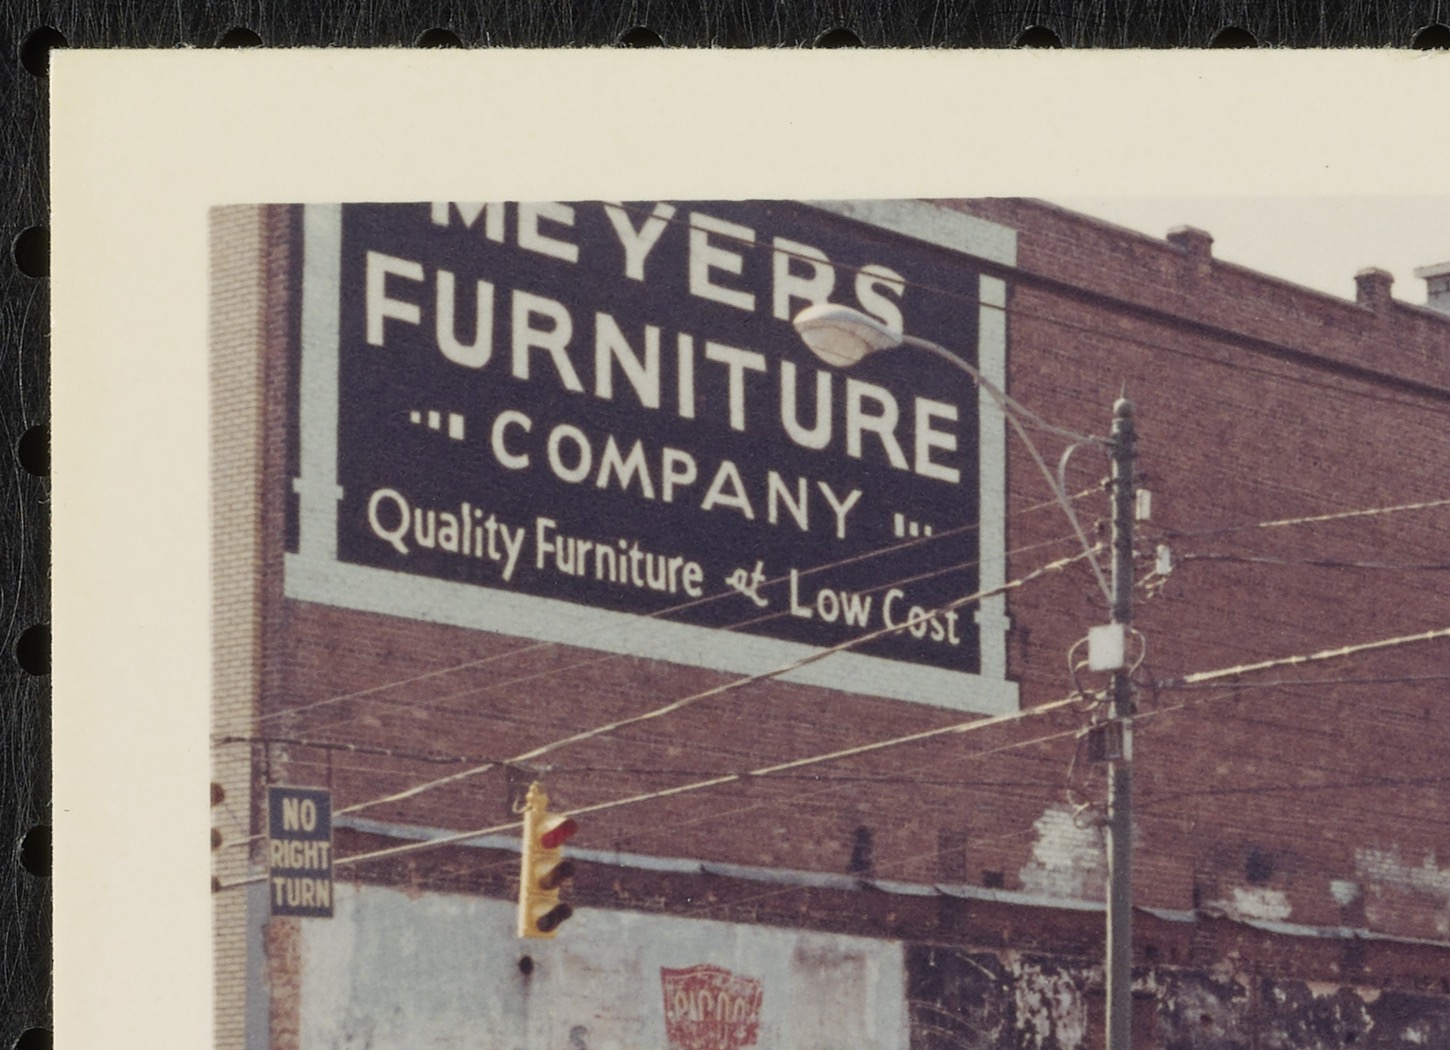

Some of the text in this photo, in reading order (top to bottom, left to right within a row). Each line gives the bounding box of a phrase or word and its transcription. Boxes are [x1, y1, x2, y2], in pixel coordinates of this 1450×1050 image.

[366, 251, 960, 483] FURNITURE
[492, 410, 862, 539] COMPANY
[368, 488, 960, 644] Quality Furniture at Low Cost
[271, 839, 330, 869] RIGHT
[282, 798, 317, 831] NO
[273, 876, 330, 907] TURN
